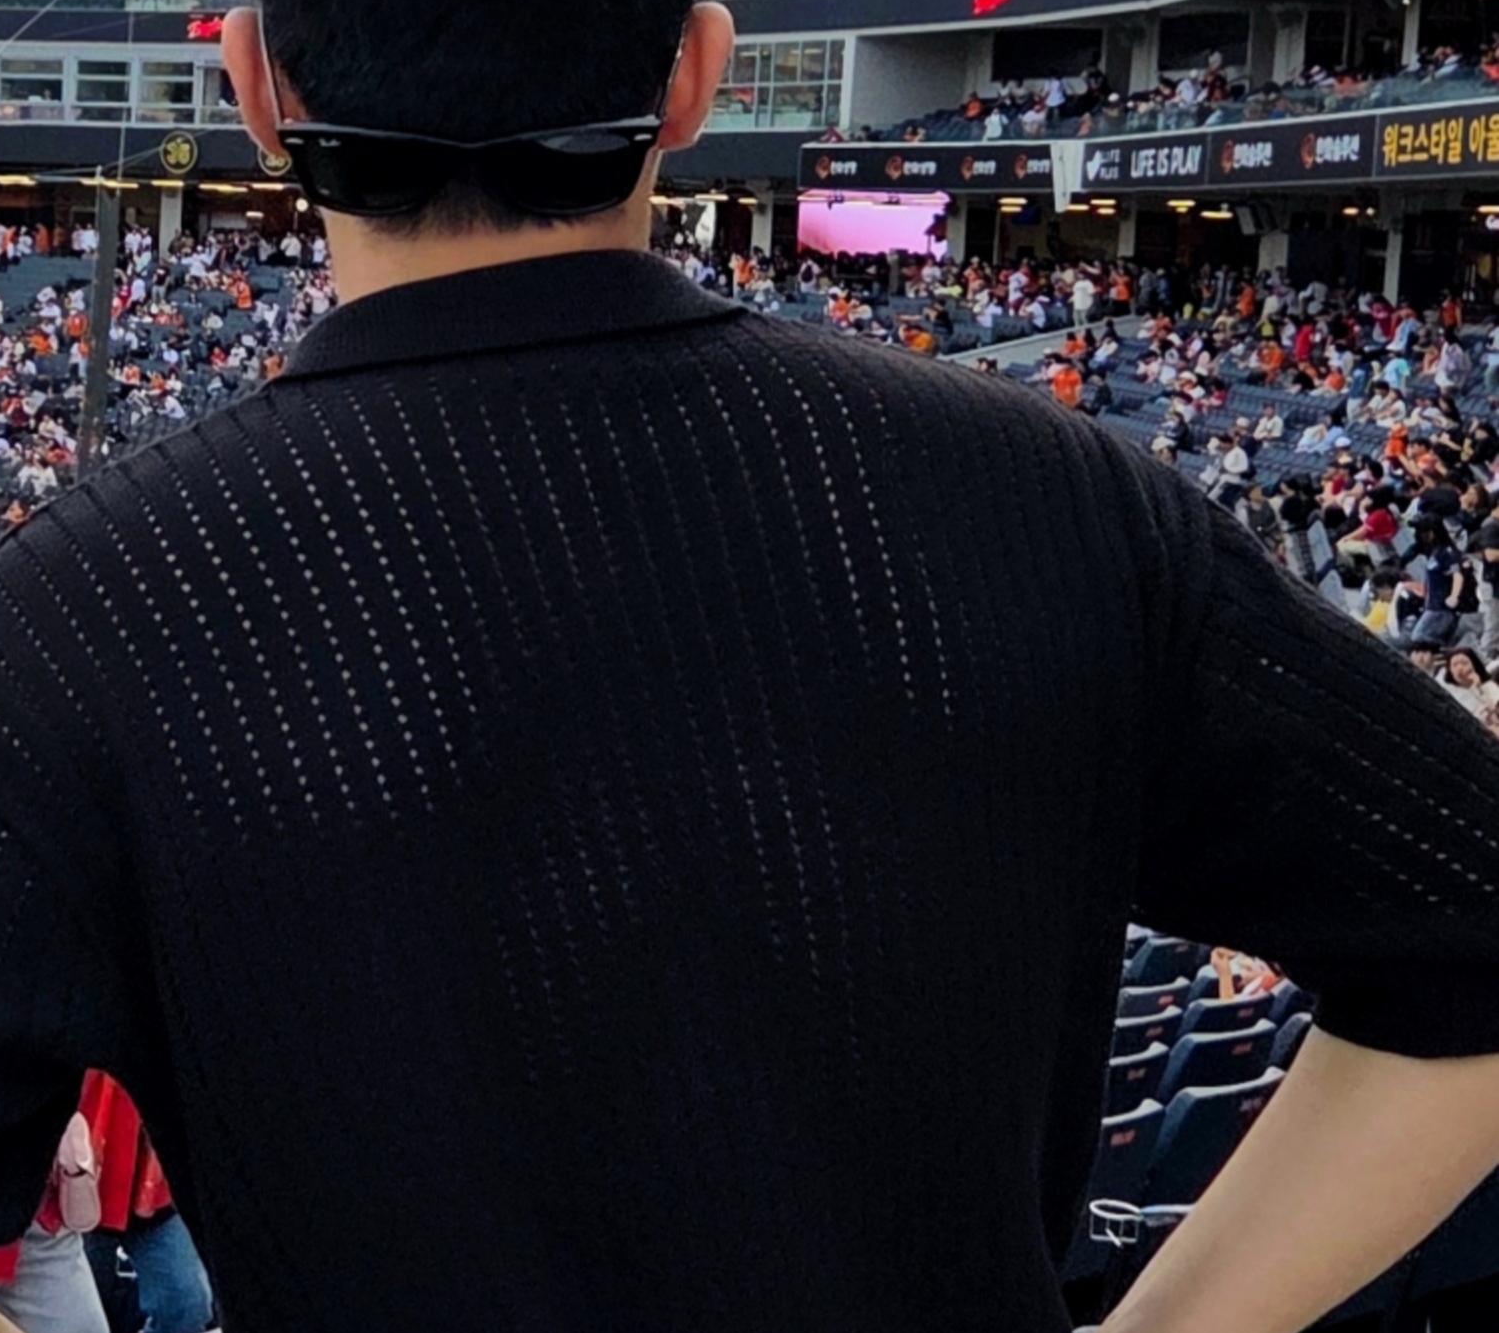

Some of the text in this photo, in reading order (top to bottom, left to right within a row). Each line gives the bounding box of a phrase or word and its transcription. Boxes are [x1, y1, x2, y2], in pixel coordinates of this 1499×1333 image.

[1130, 146, 1203, 179] LIFE IS PLAY
[1382, 117, 1464, 167] 워크스타일
